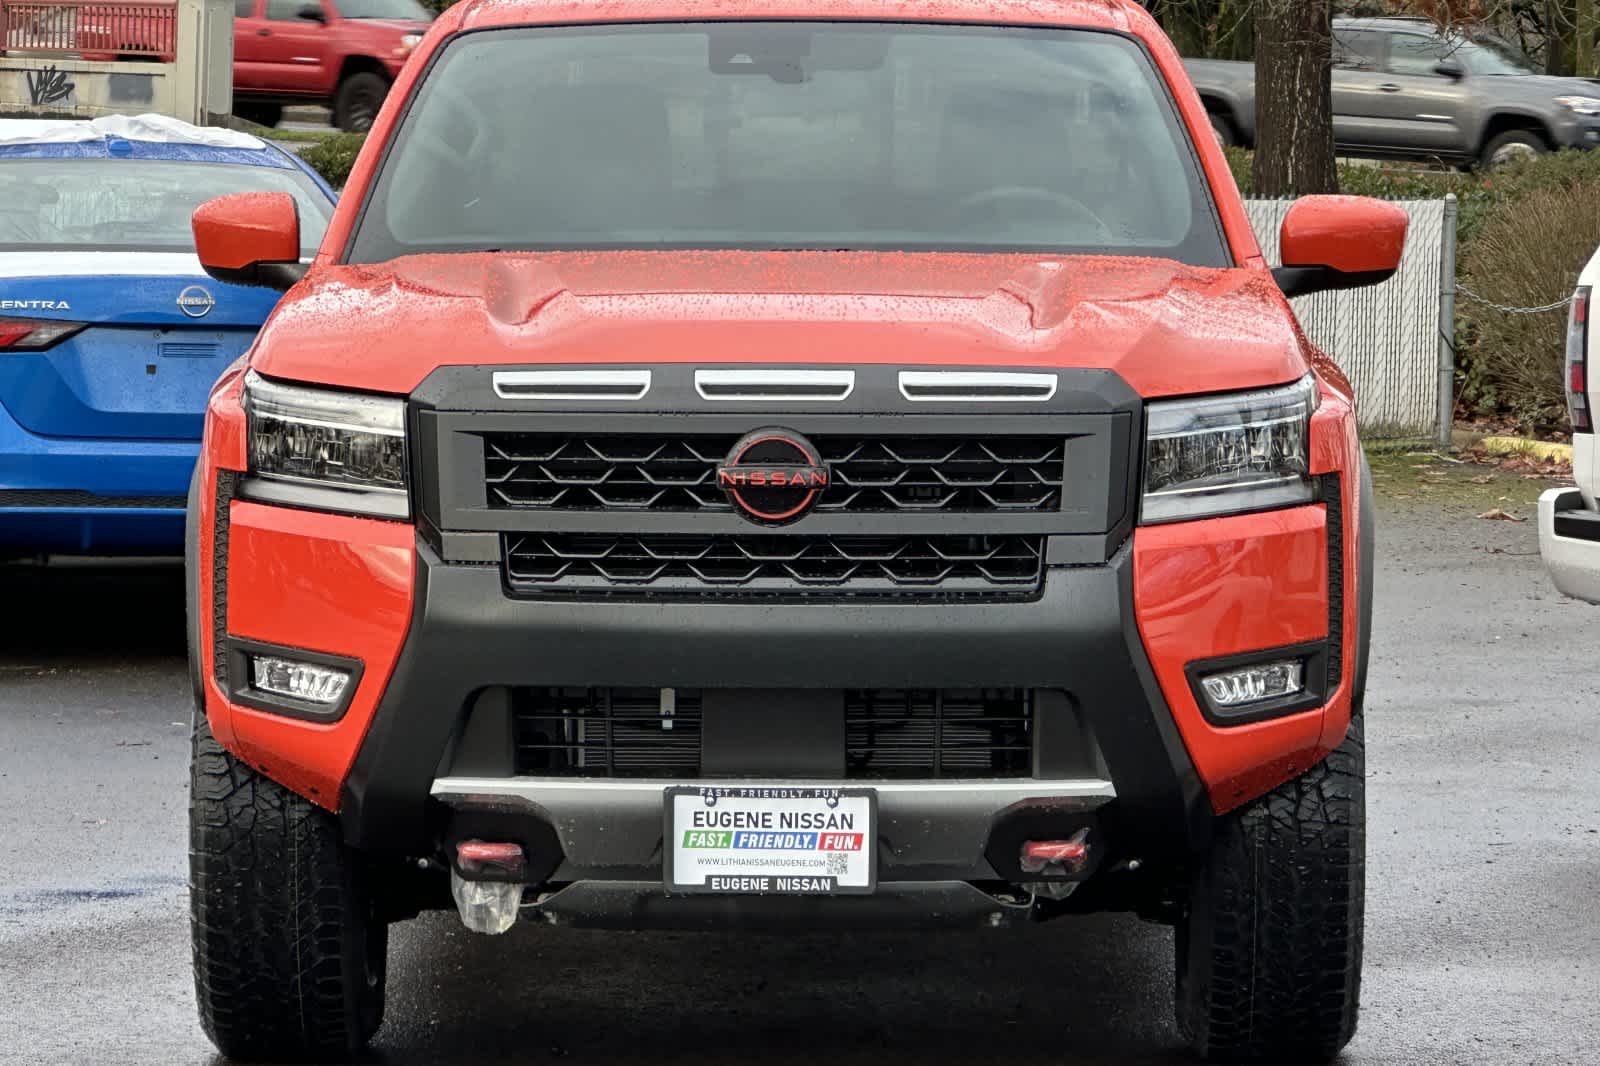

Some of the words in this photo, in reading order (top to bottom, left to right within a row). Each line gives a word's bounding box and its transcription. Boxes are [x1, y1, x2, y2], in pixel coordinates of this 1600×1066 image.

[0, 300, 71, 310] ENTRA
[176, 297, 215, 305] NISSAN
[719, 470, 827, 486] NISSAN
[693, 811, 773, 828] EUGENE
[779, 812, 854, 830] NISSAN
[687, 832, 728, 848] FAST.
[738, 833, 813, 849] FRIENDLY.
[823, 835, 859, 850] FUN.
[711, 877, 769, 890] EUGENE
[776, 878, 831, 891] NISSAN
